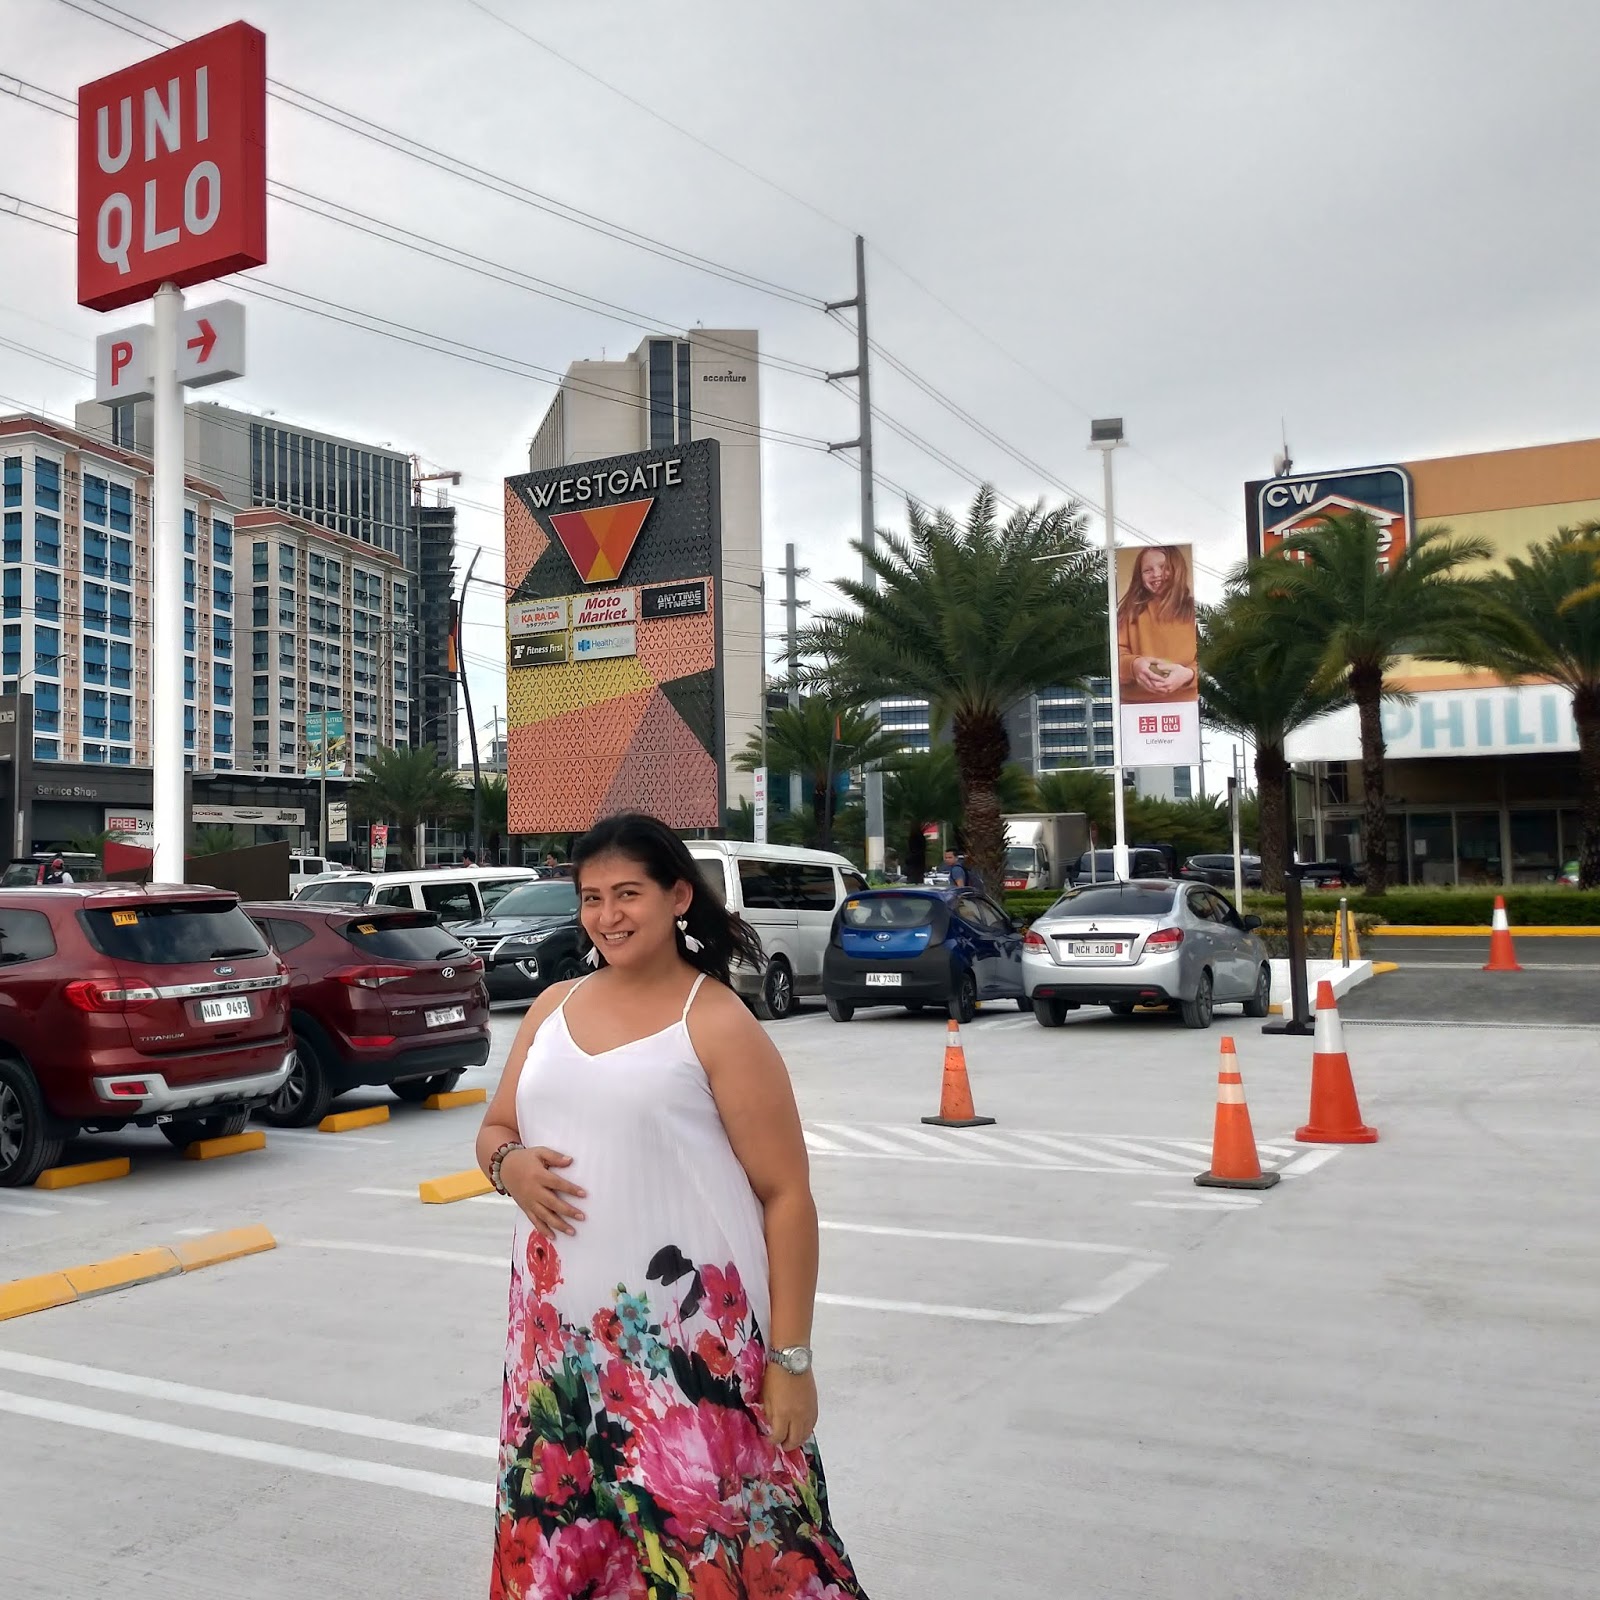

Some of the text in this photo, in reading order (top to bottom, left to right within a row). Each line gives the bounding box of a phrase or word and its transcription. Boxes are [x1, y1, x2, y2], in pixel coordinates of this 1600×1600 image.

[97, 66, 209, 174] UNI
[97, 160, 221, 275] QLO
[111, 341, 133, 387] P
[527, 459, 682, 508] WESTGATE
[1267, 483, 1318, 507] CW
[585, 596, 621, 610] Moto
[657, 590, 701, 603] ANYTIME
[658, 599, 701, 610] FITNESS
[578, 608, 627, 624] Market
[37, 784, 98, 798] Service Shop
[110, 818, 135, 829] FREE
[868, 975, 900, 983] AAK 7303
[203, 1001, 249, 1018] NAD 9493
[140, 1033, 185, 1042] TITANIUM
